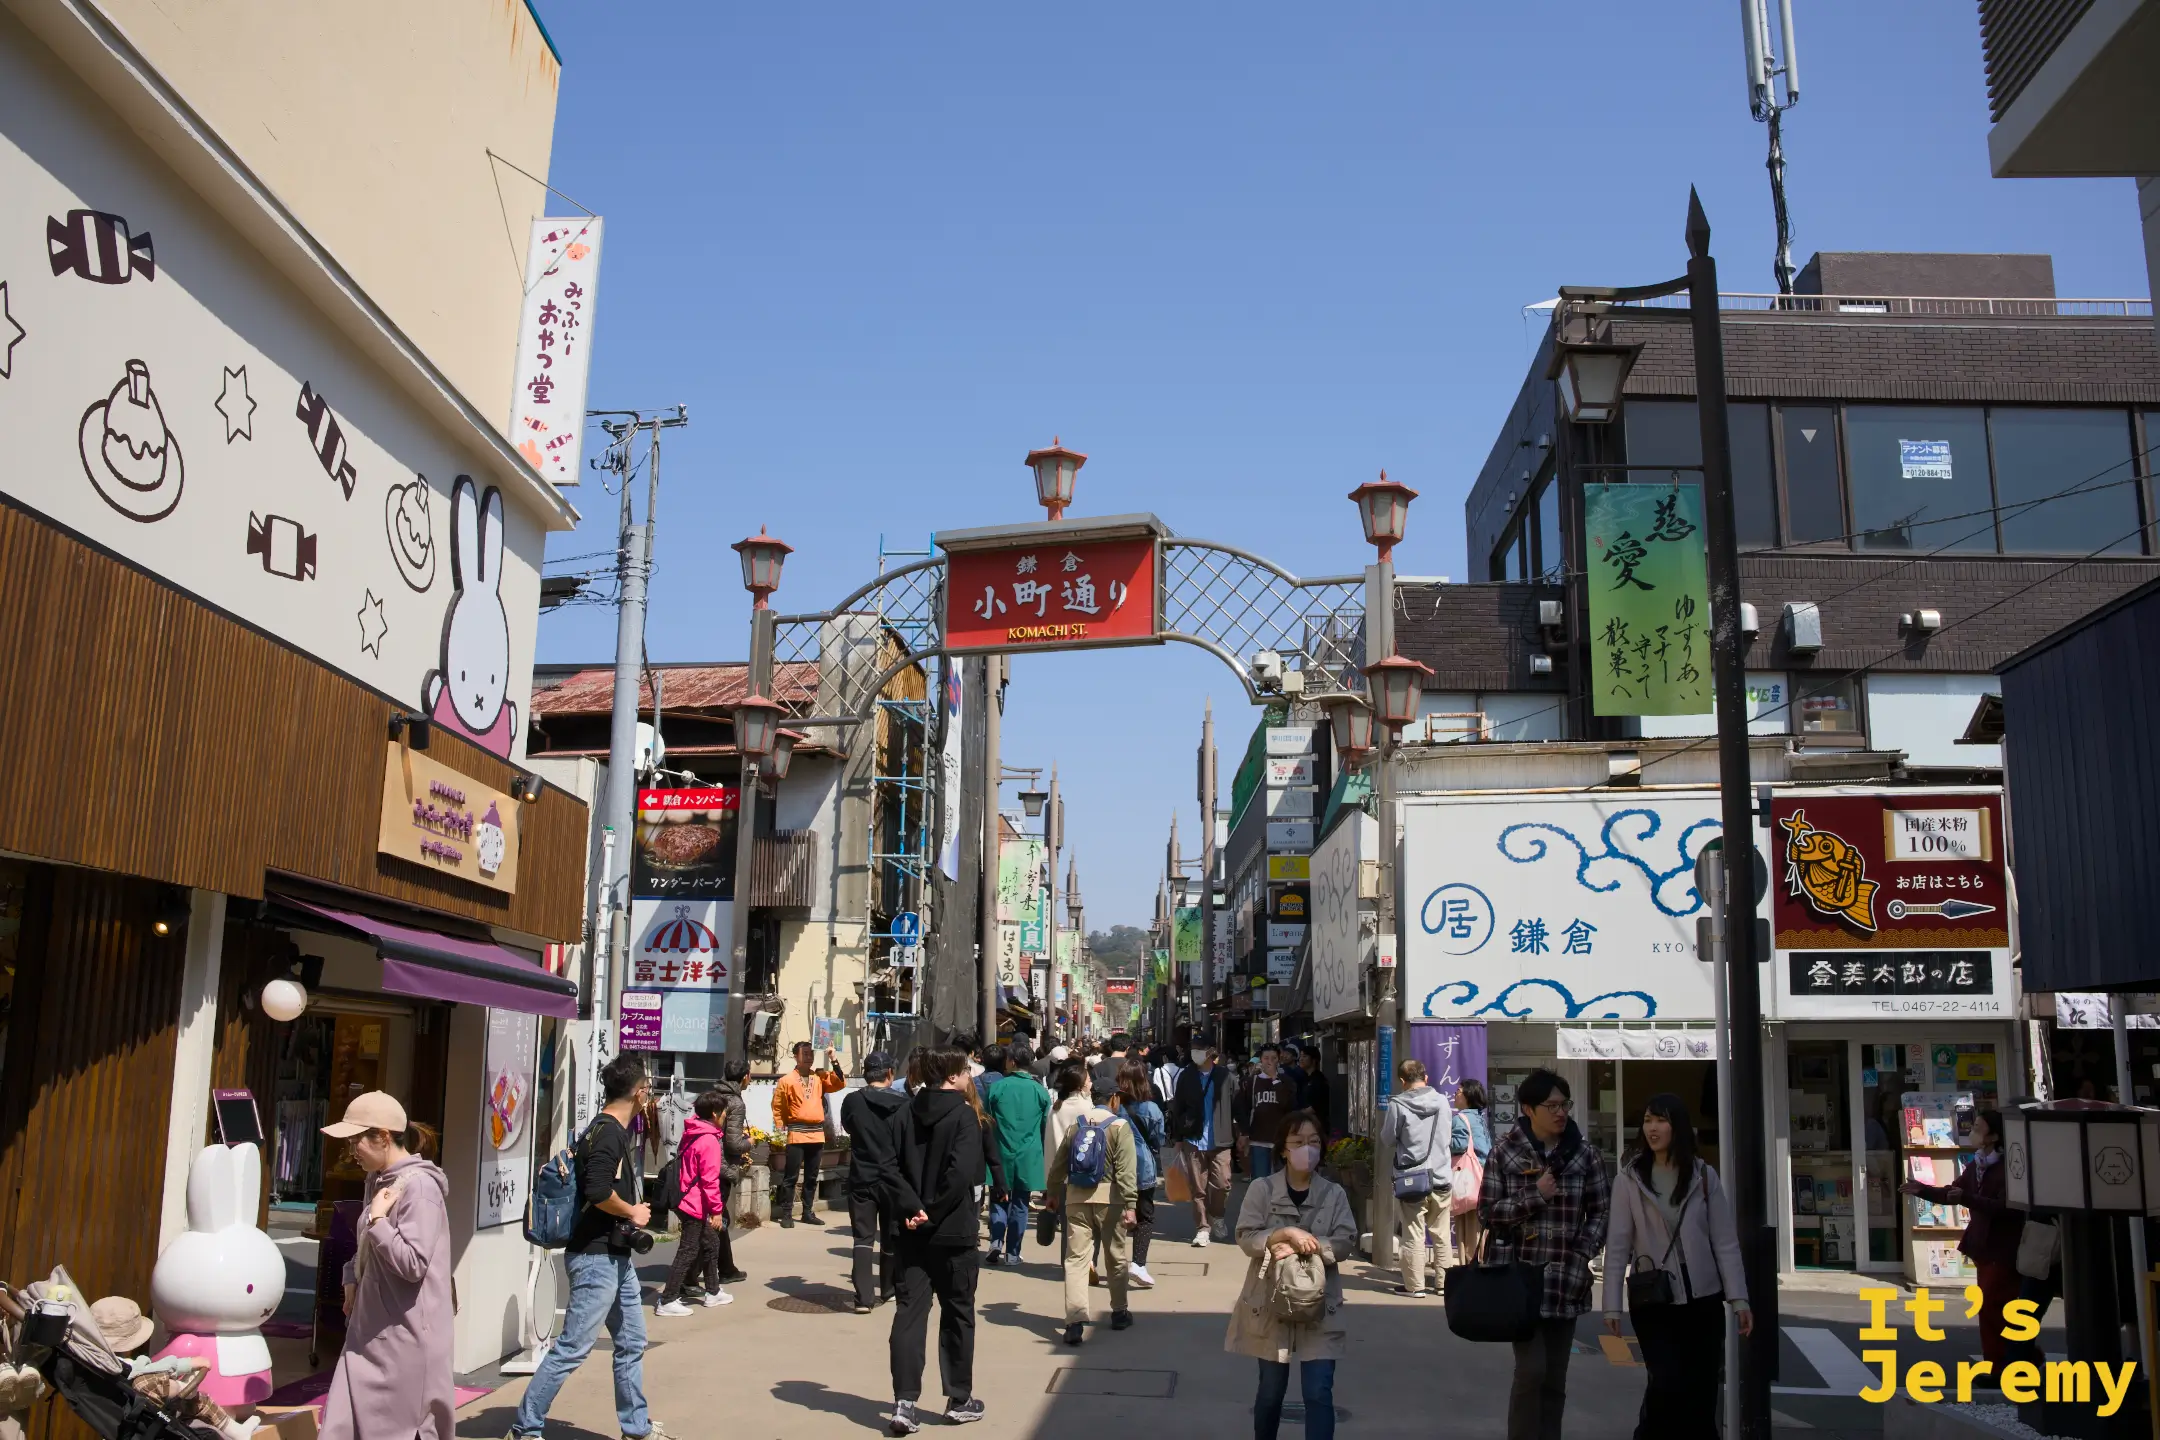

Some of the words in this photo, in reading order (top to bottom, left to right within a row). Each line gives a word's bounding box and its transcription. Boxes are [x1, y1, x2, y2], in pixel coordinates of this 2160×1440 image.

[562, 281, 583, 356] みっふぃー
[527, 299, 561, 403] おやつ堂
[1902, 445, 1948, 454] テナント募集
[1016, 551, 1084, 575] 鎌倉
[974, 574, 1128, 620] 小町通り
[1008, 624, 1068, 639] KOMACHI
[1071, 623, 1089, 635] ST.
[1597, 617, 1632, 698] 散策へ
[1653, 625, 1673, 683] マナー
[1674, 594, 1700, 700] ゆずりあい
[1631, 634, 1650, 699] 守って
[1905, 817, 1968, 832] 国産米粉
[1908, 835, 1967, 853] 100%
[1896, 875, 1984, 890] お店はこちら
[1508, 917, 1598, 956] 鎌倉
[1653, 943, 1684, 953] KYO
[893, 951, 918, 963] 12-1
[1002, 930, 1015, 982] はきもの
[1808, 961, 1974, 986] 登美太郎の店
[620, 1012, 645, 1021] カーブス
[1872, 1001, 2000, 1012] TEL.0467-22-4114
[665, 1013, 707, 1031] Moana
[488, 1180, 516, 1208] どらやき
